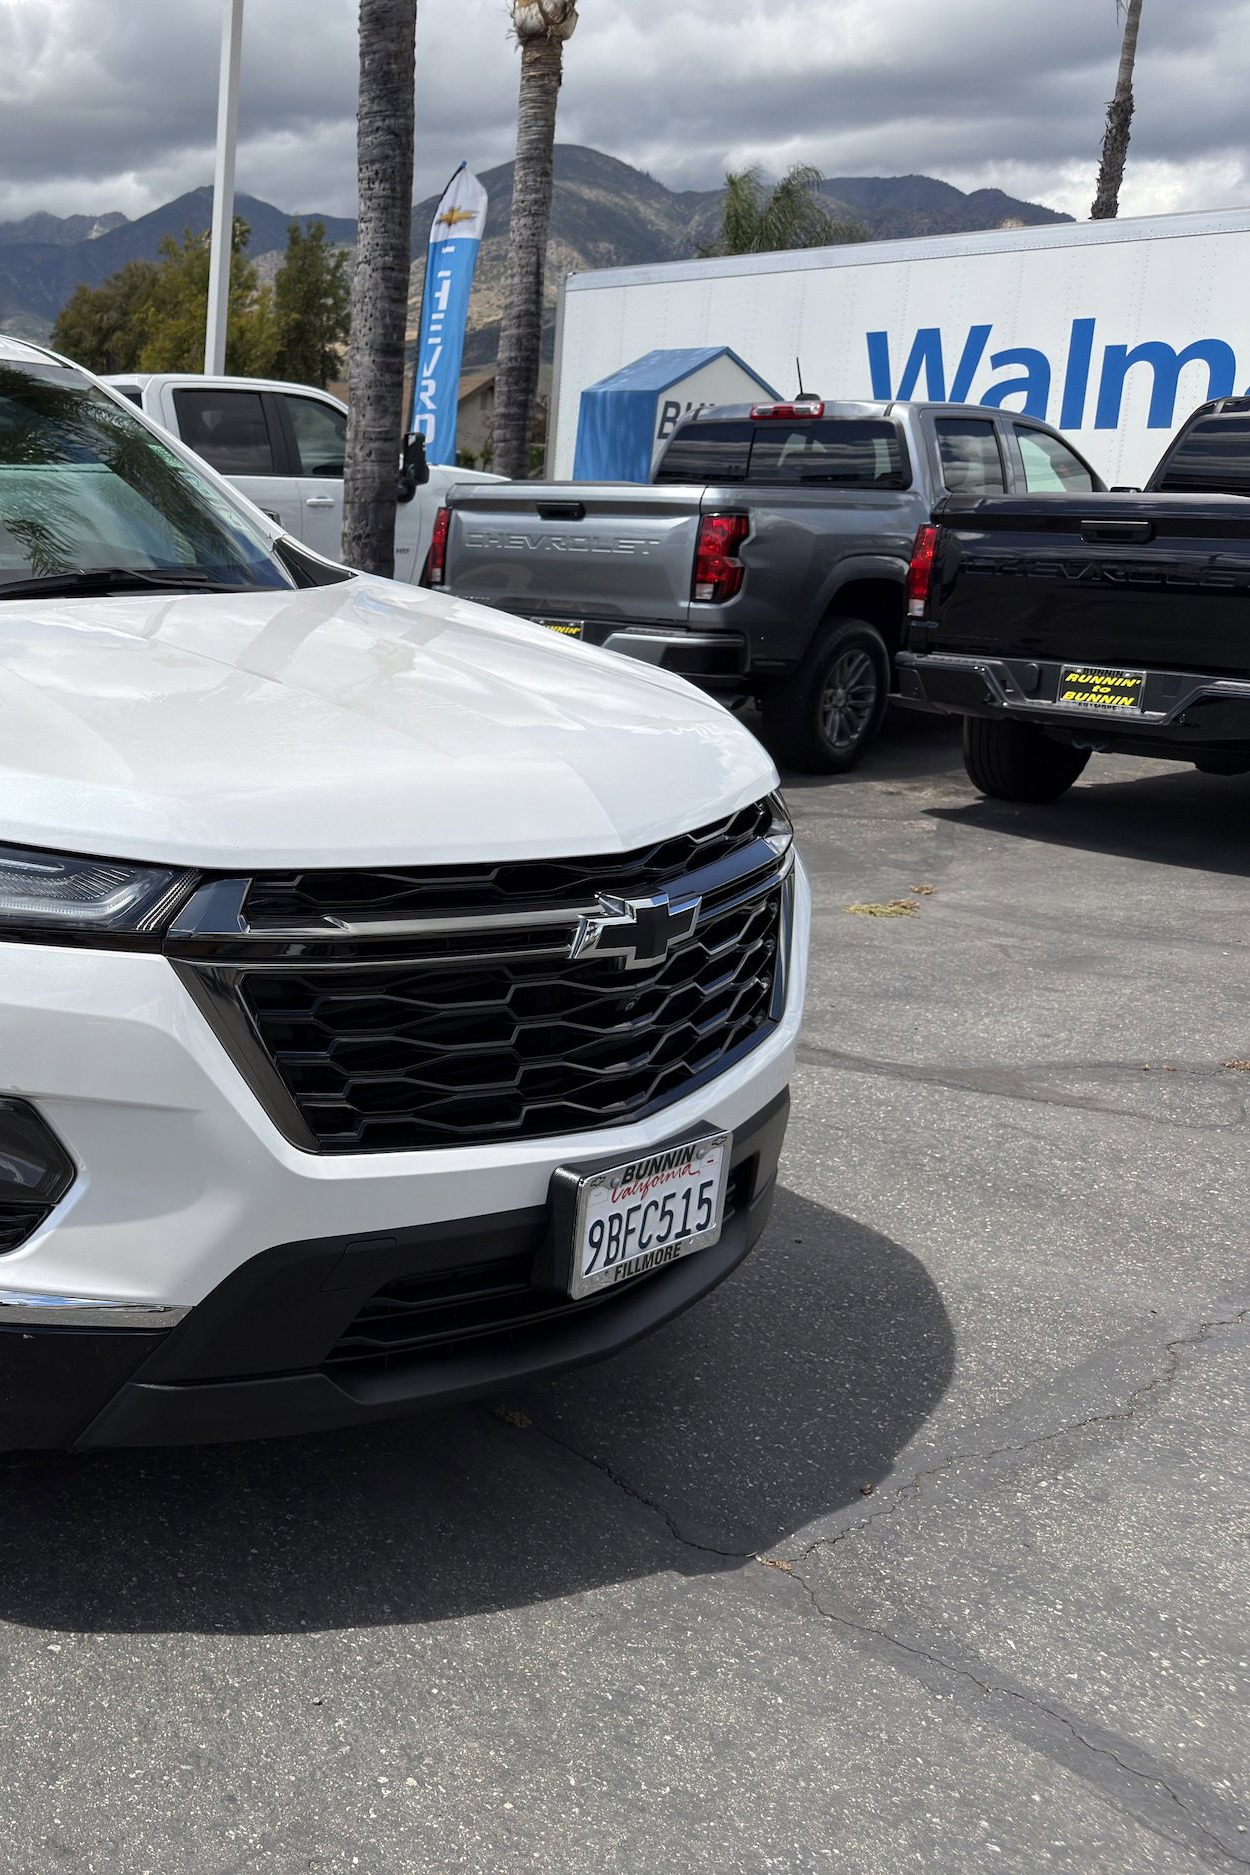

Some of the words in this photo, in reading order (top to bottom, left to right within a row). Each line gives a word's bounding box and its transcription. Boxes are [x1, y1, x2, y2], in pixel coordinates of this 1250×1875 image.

[865, 316, 1250, 430] Walm
[465, 532, 660, 554] CHEVROLET
[1065, 673, 1141, 687] RUNNIN'
[1083, 668, 1124, 677] BUNNIN
[1062, 691, 1135, 706] BUNNIN
[1091, 685, 1111, 693] to
[621, 1145, 696, 1185] BUNNIN
[611, 1162, 701, 1204] California
[585, 1179, 714, 1275] 9BFC515
[614, 1241, 682, 1281] FILLMORE
